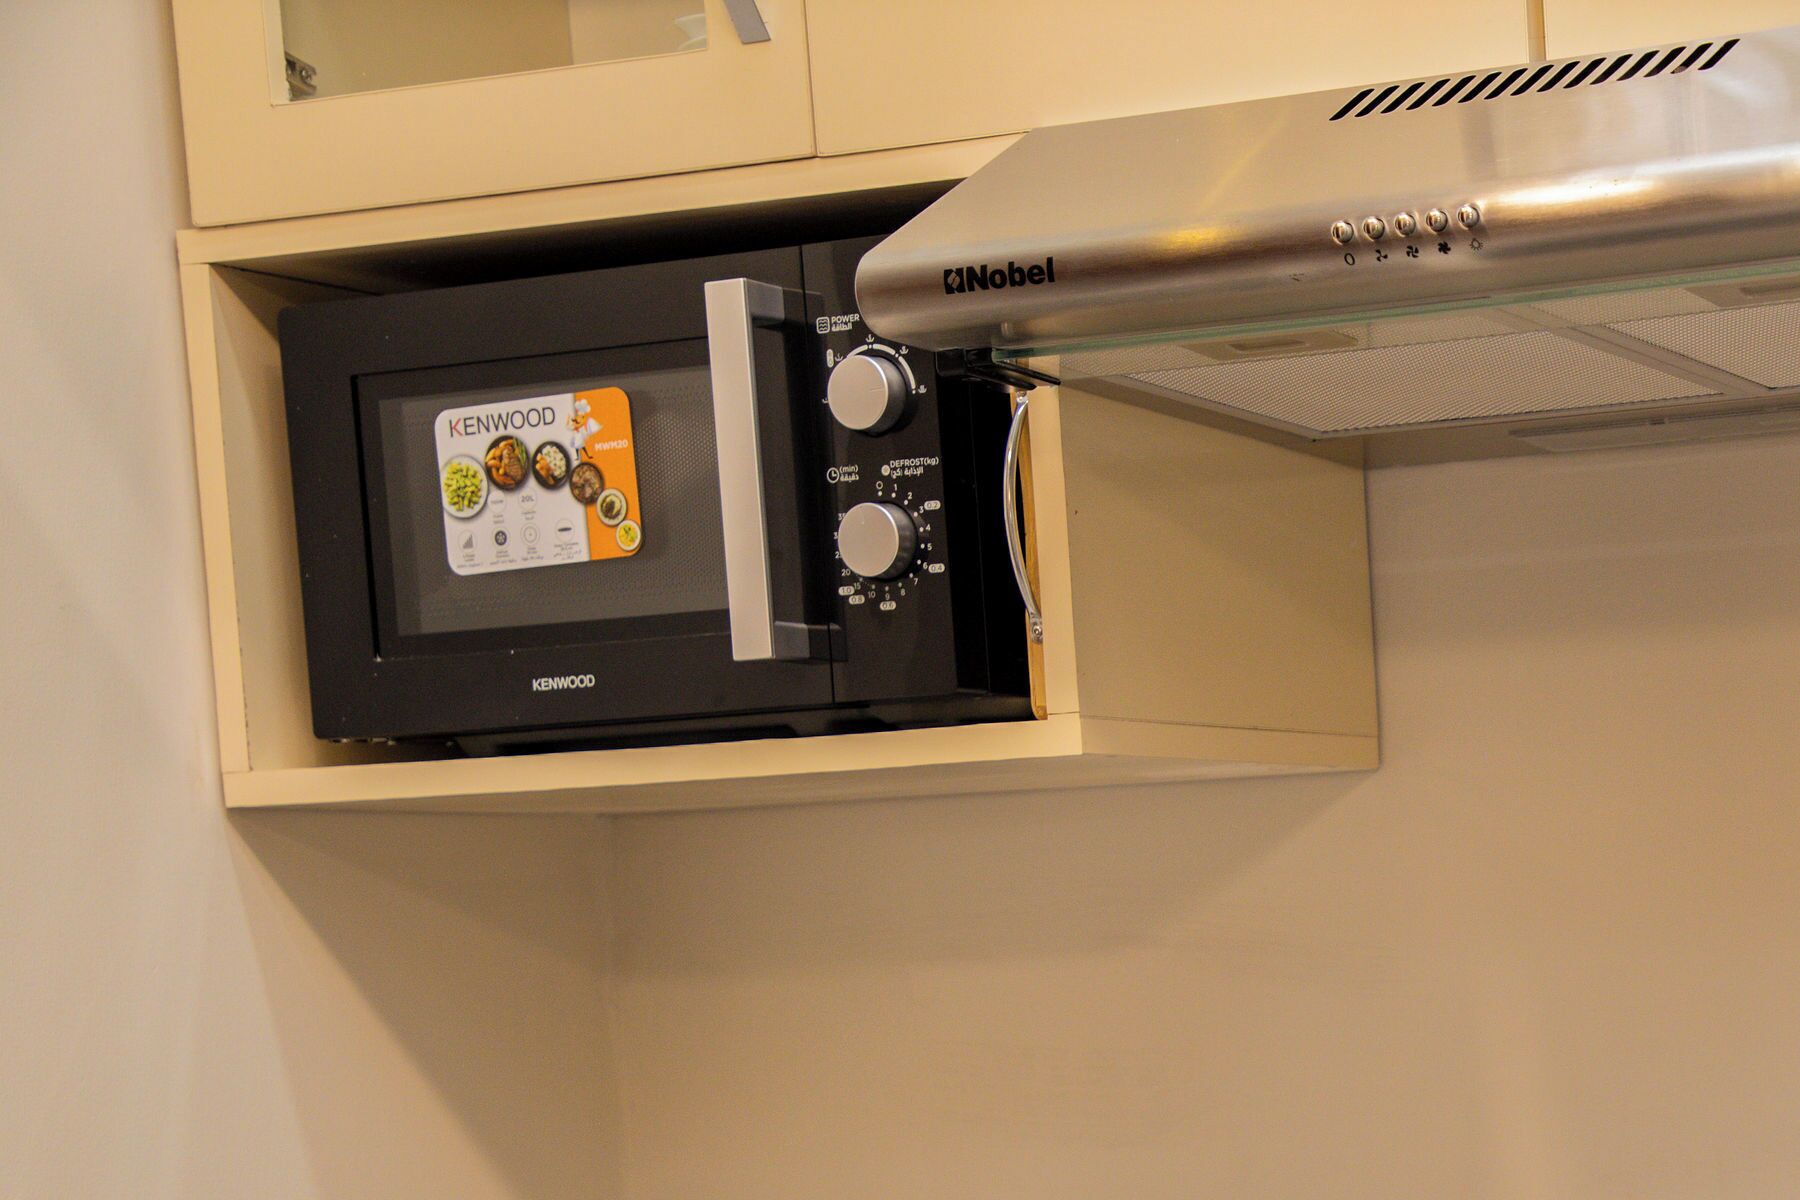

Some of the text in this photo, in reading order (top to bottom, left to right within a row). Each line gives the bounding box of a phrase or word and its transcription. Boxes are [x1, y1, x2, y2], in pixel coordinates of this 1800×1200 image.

[965, 256, 1056, 292] Nobel
[831, 313, 860, 323] POWER
[448, 406, 556, 438] KENWOOD
[594, 439, 629, 451] MWM20
[839, 464, 859, 474] (min)
[907, 492, 913, 500] 2
[919, 505, 924, 514] 3
[927, 543, 933, 551] 5
[923, 562, 928, 570] 6
[854, 582, 861, 590] 15
[913, 578, 919, 586] 7
[868, 591, 876, 599] 10
[532, 674, 596, 691] KENWOOD
